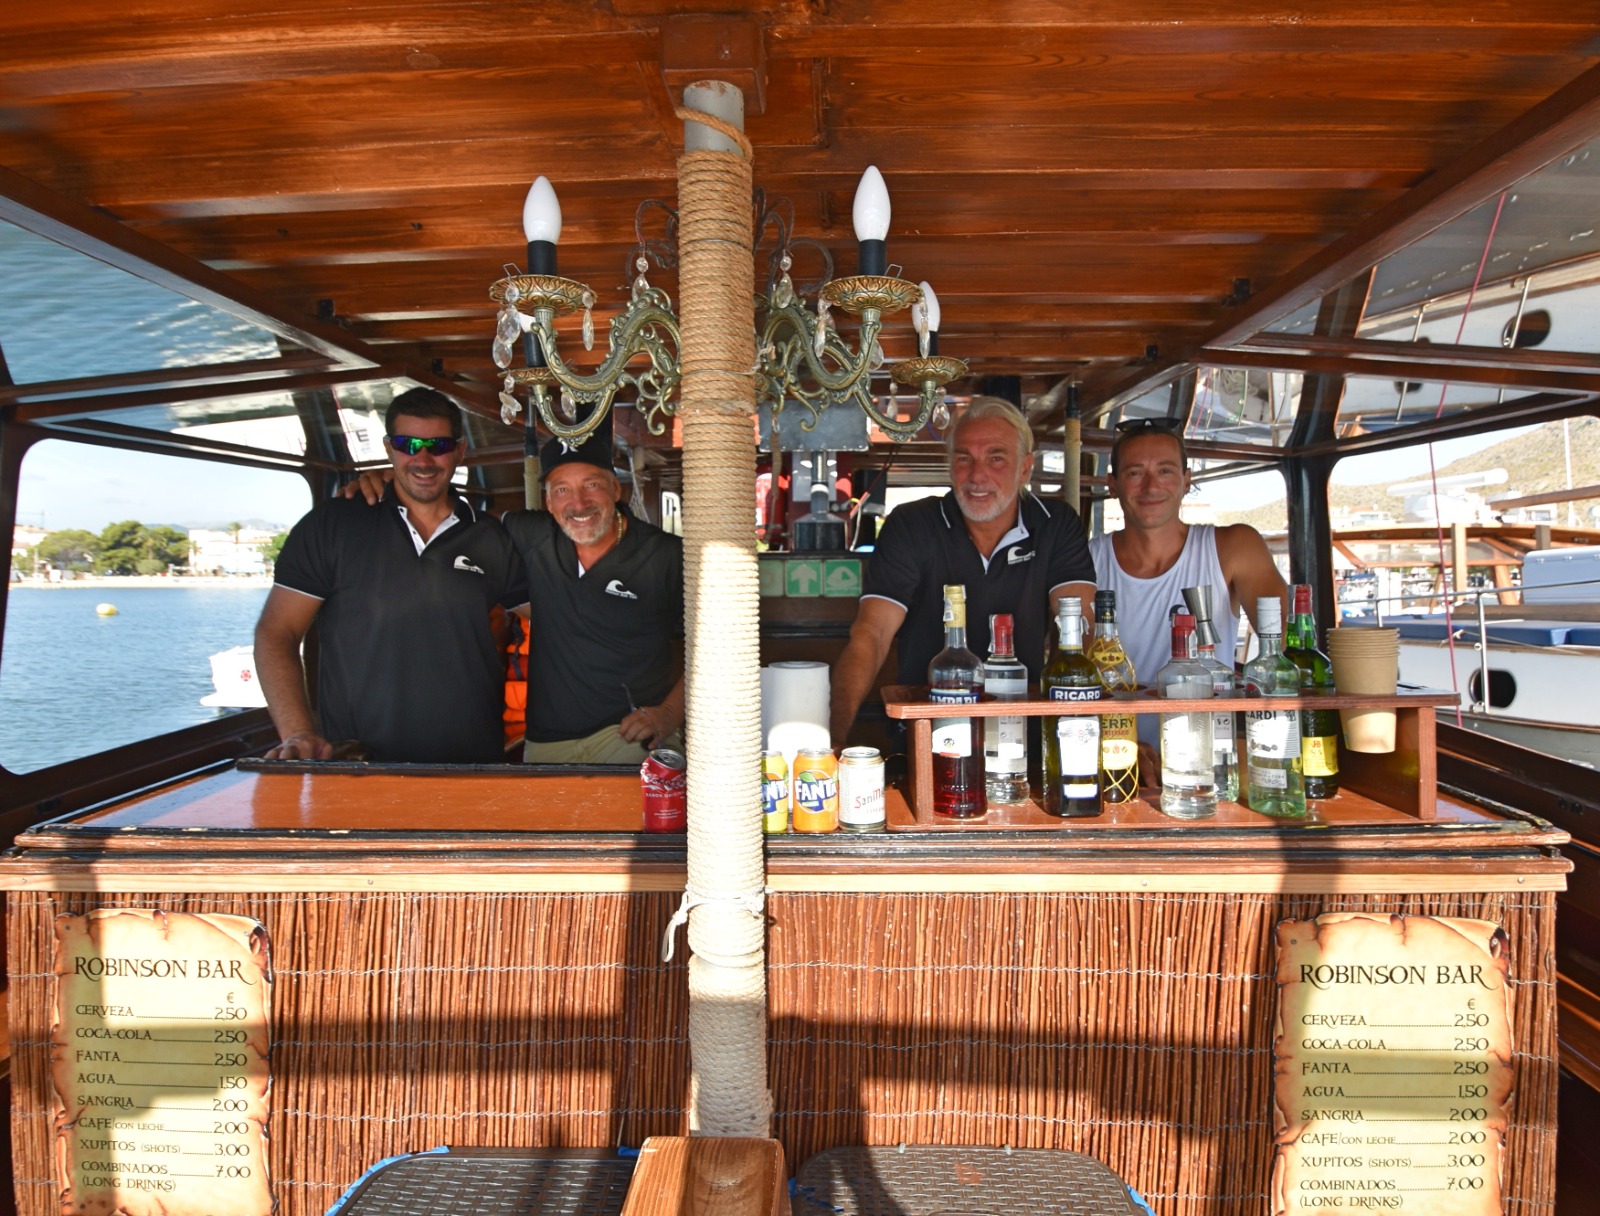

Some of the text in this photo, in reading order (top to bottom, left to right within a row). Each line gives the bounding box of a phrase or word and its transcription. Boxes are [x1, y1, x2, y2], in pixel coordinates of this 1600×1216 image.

[1055, 688, 1100, 700] RICARD
[1102, 717, 1134, 729] ERRY
[794, 778, 838, 801] FANTA
[74, 957, 258, 985] ROBINSON BAR
[1299, 964, 1500, 990] ROBINSON BAR
[226, 992, 234, 1003] €
[1467, 998, 1475, 1010] €
[76, 1004, 134, 1020] CERVEZA
[1301, 1014, 1367, 1029] CERVEZA
[76, 1028, 152, 1042] COCA-COLA
[1301, 1038, 1387, 1051] COCA-COLA
[76, 1050, 121, 1063] FANTA
[1302, 1062, 1352, 1076] FANTA
[77, 1073, 116, 1084] AGUA
[1302, 1086, 1345, 1097] AGUA
[77, 1095, 135, 1111] SANGRIA
[1301, 1109, 1364, 1124] SANGRIA
[137, 1123, 165, 1131] LECHE
[80, 1139, 136, 1151] XUPITOS
[141, 1143, 181, 1154] (SHOTS)
[1366, 1136, 1396, 1145] LECHE
[81, 1161, 168, 1174] COMBINADOS
[1301, 1157, 1363, 1167] XUPITOS
[1368, 1158, 1412, 1168] (SHOTS)
[82, 1175, 176, 1192] (LONG DRINKS)
[1300, 1179, 1396, 1190] COMBINADOS
[1300, 1195, 1403, 1210] (LONG DRINKS)
